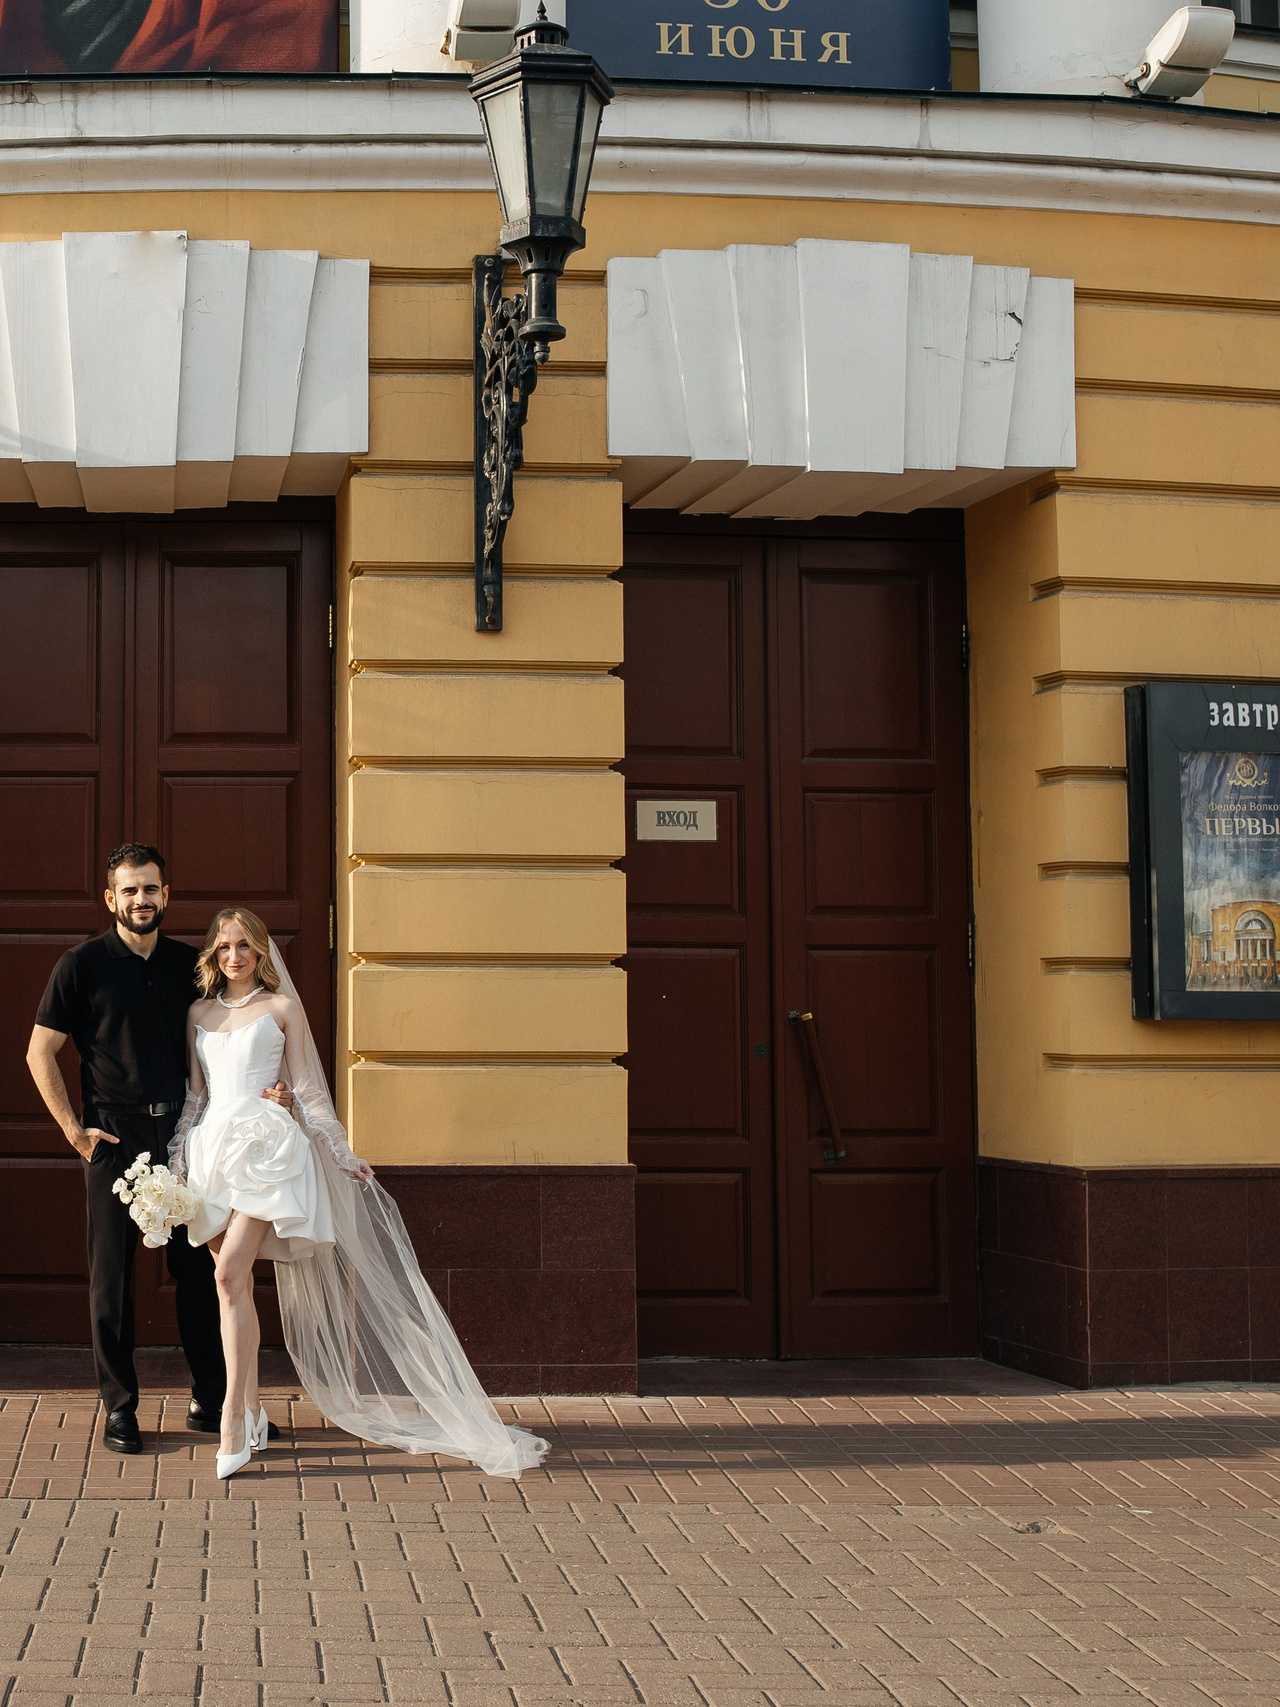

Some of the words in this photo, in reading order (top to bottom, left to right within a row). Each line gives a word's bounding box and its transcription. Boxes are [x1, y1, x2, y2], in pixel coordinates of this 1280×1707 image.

[655, 22, 852, 64] июня
[1208, 802, 1247, 813] Федора
[1249, 801, 1280, 811] Волко
[655, 810, 699, 831] ВХОД
